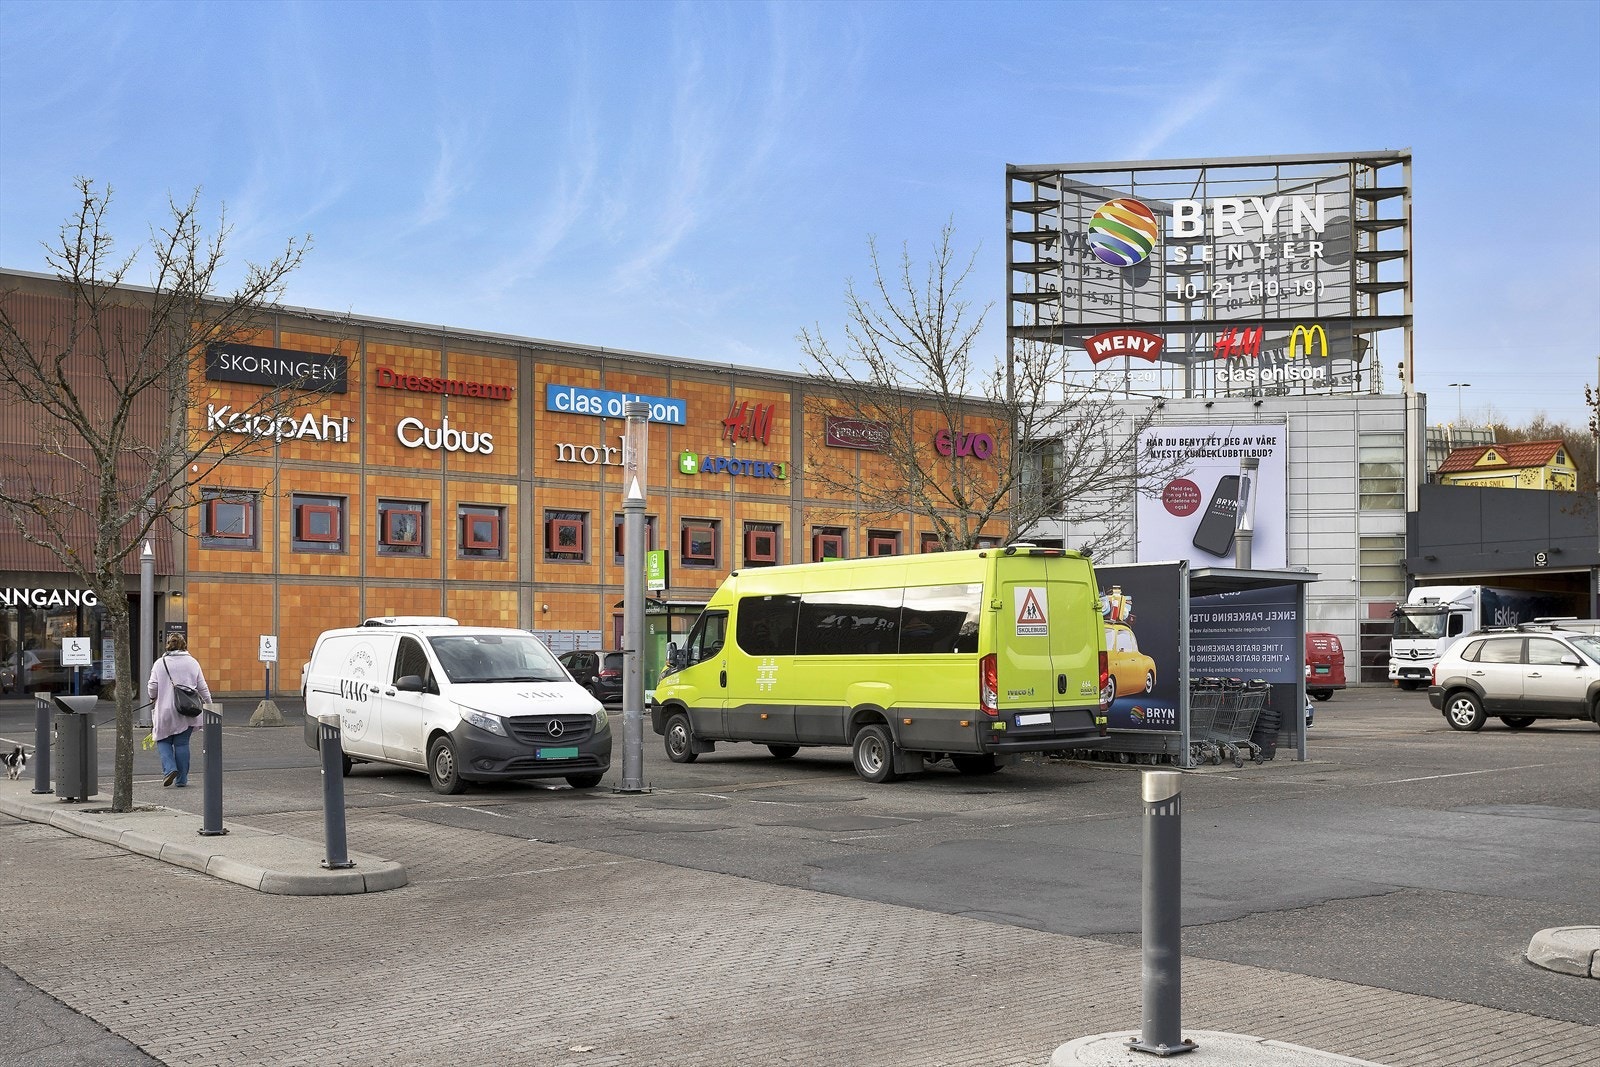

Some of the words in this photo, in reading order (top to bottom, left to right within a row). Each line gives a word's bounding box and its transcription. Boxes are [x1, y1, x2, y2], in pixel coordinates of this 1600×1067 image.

[1172, 195, 1325, 238] BRYN
[1174, 241, 1324, 262] SENTER
[1093, 335, 1156, 355] MENY
[1214, 325, 1264, 359] H&M
[219, 352, 337, 380] SKORINGEN
[1217, 366, 1255, 382] clas
[1261, 364, 1324, 381] ohlson
[376, 367, 513, 401] Dressmann
[555, 388, 603, 415] clas
[608, 394, 679, 422] ohon
[207, 403, 349, 443] KappAhl
[397, 415, 494, 455] Cubus
[722, 400, 775, 446] H&M
[935, 428, 993, 461] evo
[1146, 438, 1163, 447] HAR
[1165, 438, 1177, 447] DU
[1179, 437, 1222, 447] BENYTTET
[1224, 437, 1240, 446] DEG
[1243, 437, 1253, 446] AV
[1256, 434, 1277, 446] VÅRE
[1150, 449, 1182, 459] NYESTE
[1184, 448, 1273, 459] KUNDEKLUBBTILBUD?
[701, 456, 776, 479] APOTEK
[777, 462, 787, 480] 1
[1216, 498, 1239, 507] BRYN
[1494, 605, 1520, 626] isklar
[1146, 707, 1175, 719] BRYN
